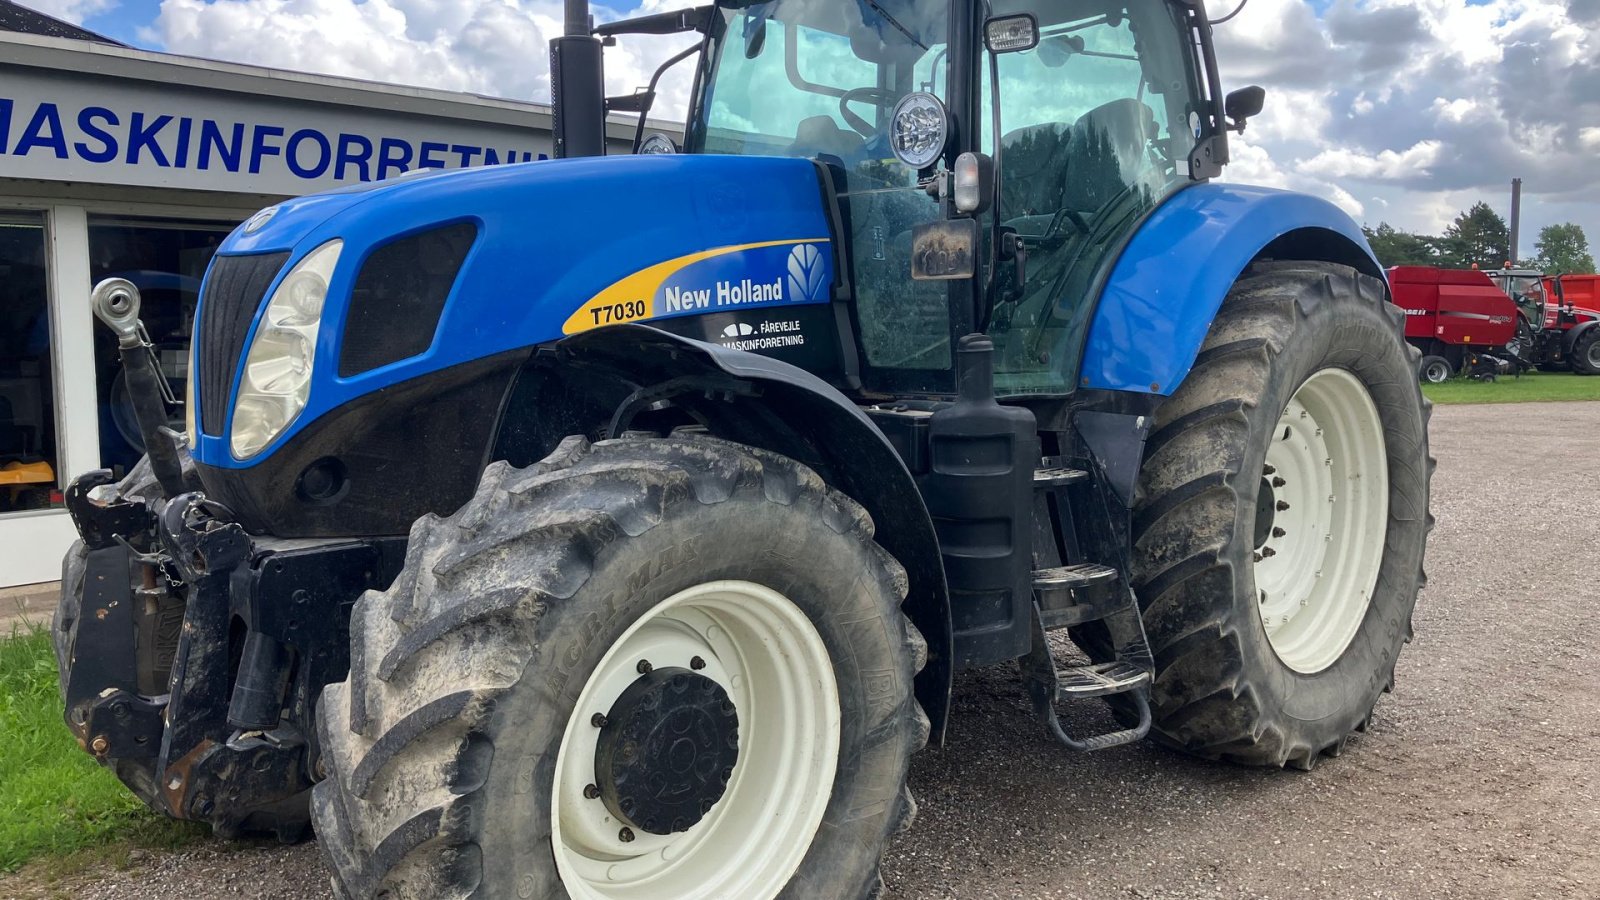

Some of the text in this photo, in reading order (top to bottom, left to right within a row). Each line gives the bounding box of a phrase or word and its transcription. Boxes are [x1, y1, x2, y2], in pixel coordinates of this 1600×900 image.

[0, 98, 550, 182] ASKINFORRET
[665, 277, 783, 312] New Holland
[590, 300, 646, 325] T7030
[760, 320, 801, 333] FÅREVEJLE
